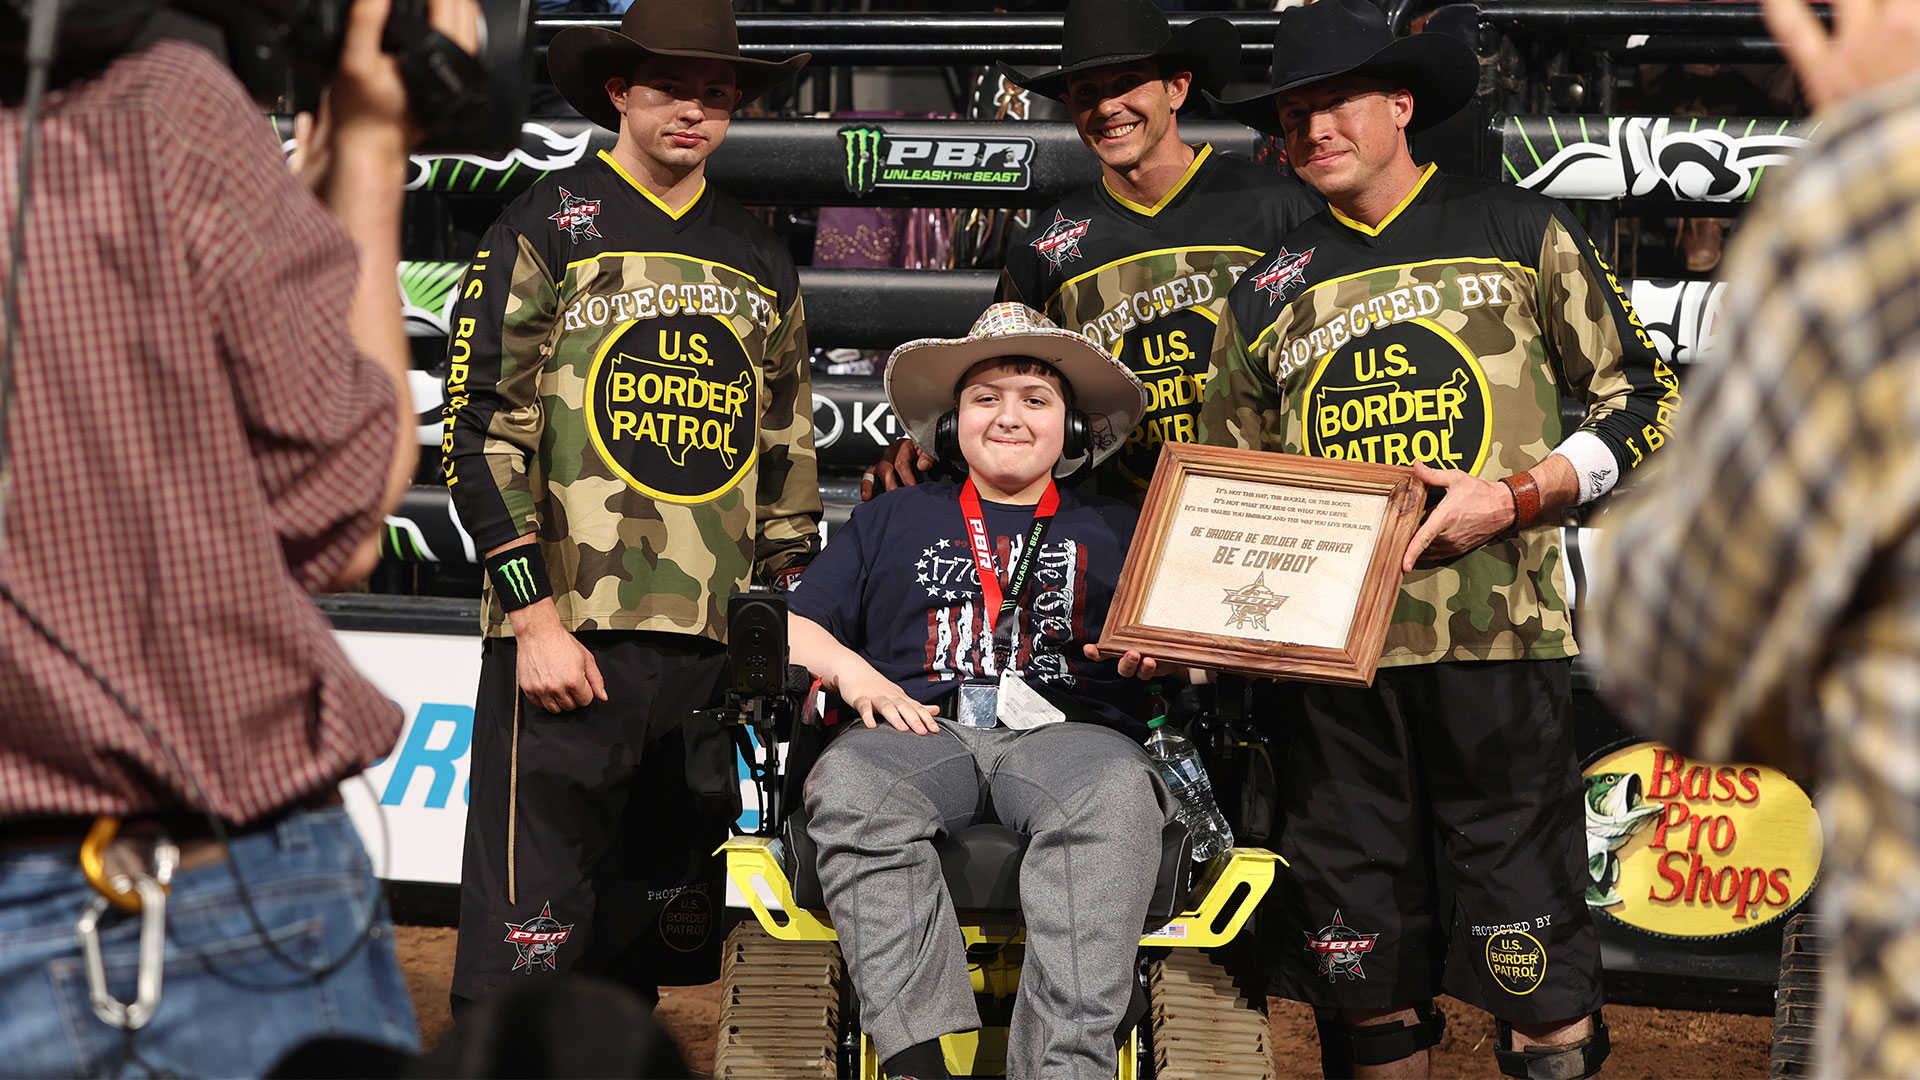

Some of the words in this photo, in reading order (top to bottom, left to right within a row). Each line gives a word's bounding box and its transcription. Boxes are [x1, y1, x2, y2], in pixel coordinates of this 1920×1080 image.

[886, 140, 1028, 168] PBR
[883, 169, 952, 182] UNLEASH
[953, 171, 973, 181] THE
[973, 171, 1021, 183] BEAST
[564, 283, 738, 331] ROTECTED
[1278, 284, 1441, 379] ROTECTED
[1456, 274, 1504, 306] BY
[658, 329, 714, 366] U.S.
[1142, 330, 1196, 366] U.S.
[1353, 343, 1417, 382] U.S.
[612, 371, 745, 418] BORDER
[1319, 387, 1464, 438] BORDER
[612, 409, 738, 455] PATROL
[969, 518, 993, 570] PBR
[1190, 526, 1205, 537] BE
[1205, 528, 1243, 542] BADDER
[1244, 533, 1259, 544] BE
[1260, 534, 1298, 549] BOLDER
[1301, 538, 1316, 550] BE
[1316, 540, 1354, 554] BRAVER
[1012, 558, 1030, 596] UNLEASH
[1025, 546, 1035, 560] THE
[1031, 522, 1045, 548] BEAST
[1212, 545, 1240, 565] BE
[1241, 549, 1318, 574] COWBOY
[1645, 748, 1761, 803] Bass
[1648, 800, 1736, 852] Pro
[1648, 850, 1791, 919] Shops
[512, 930, 567, 941] PBR
[1535, 914, 1552, 929] BY
[1308, 939, 1371, 951] PBR
[1491, 951, 1538, 965] BORDER
[1501, 939, 1523, 950] U.S.
[1493, 964, 1538, 977] PATROL
